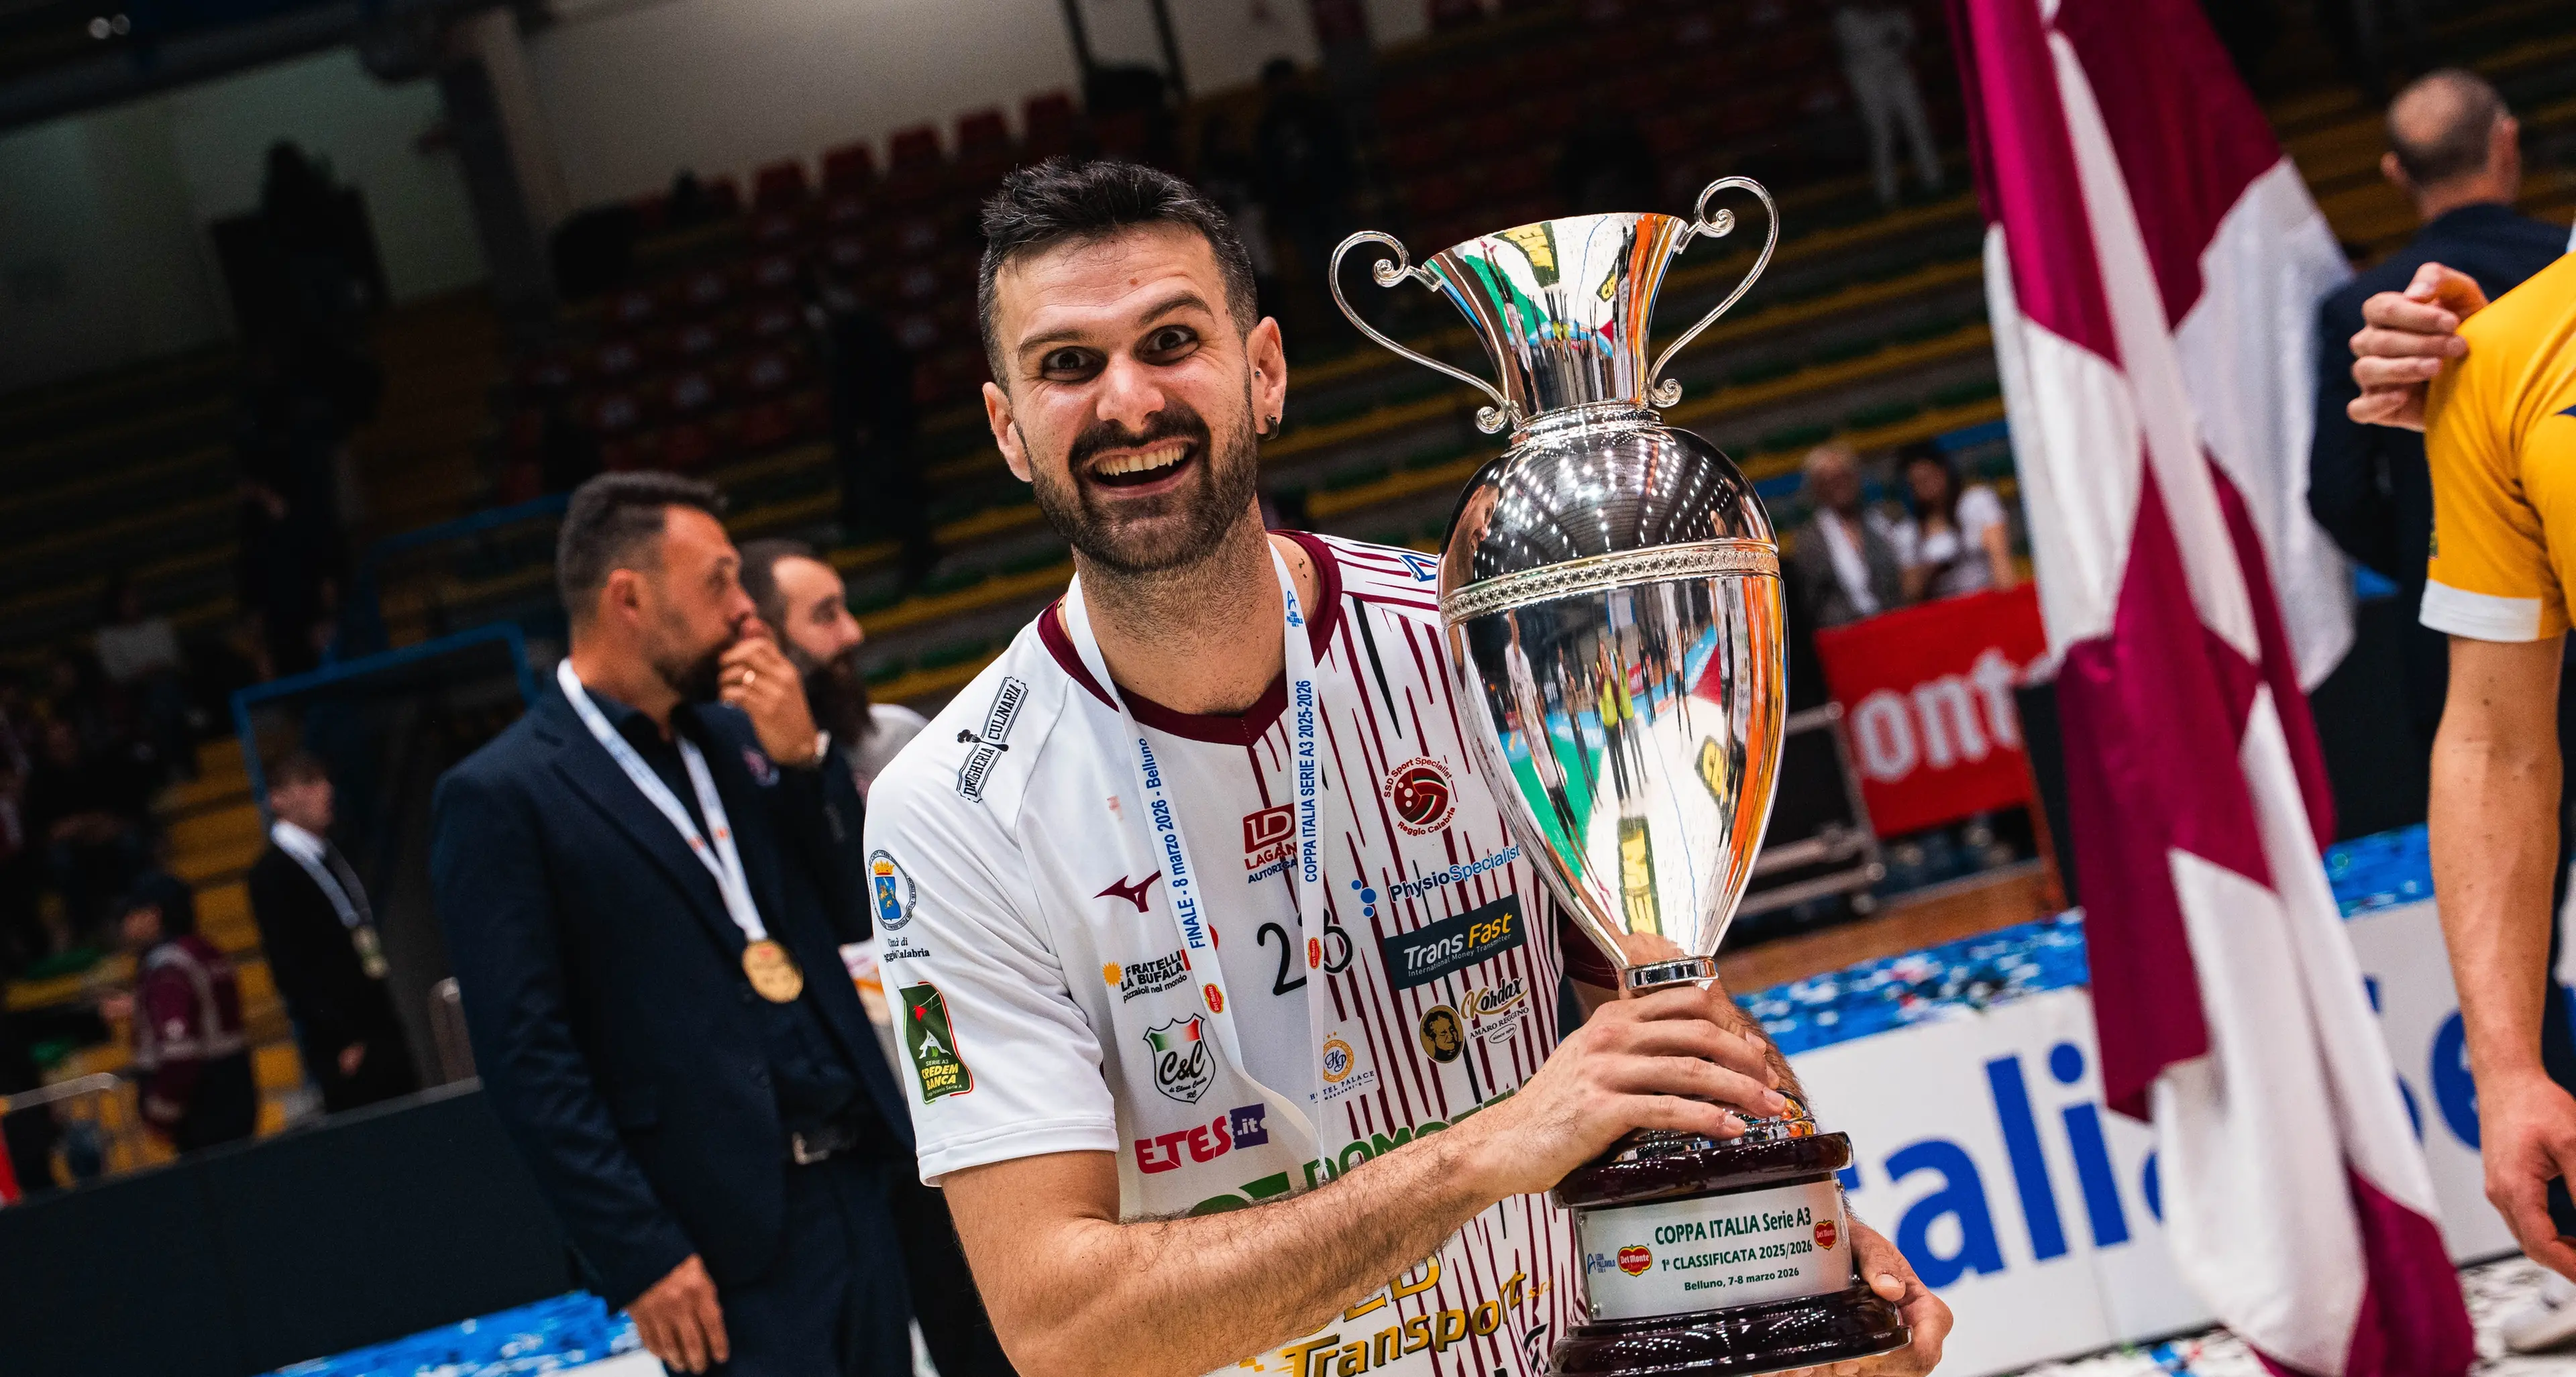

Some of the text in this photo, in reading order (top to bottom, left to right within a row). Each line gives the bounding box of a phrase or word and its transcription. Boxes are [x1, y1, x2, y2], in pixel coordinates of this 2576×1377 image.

[988, 683, 1021, 740] CULINARIA
[1138, 738, 1163, 789] Belluno
[1384, 757, 1452, 798] SSD Sport Specialist
[1295, 680, 1318, 883] COPPA ITALIA SERIE A3 2025-2026
[1150, 799, 1175, 832] 2026
[1397, 807, 1456, 837] Reggio Calabria
[1164, 834, 1186, 876] marzo
[1173, 878, 1189, 887] 8
[1389, 844, 1520, 902] PhysioSpecialist
[1177, 897, 1205, 949] FINALE
[901, 937, 908, 946] di
[1404, 912, 1513, 970] Trans Fast
[1408, 933, 1511, 977] International Money Transmitter
[1120, 962, 1185, 992] LA BUFALA
[1125, 950, 1181, 977] FRATELLI
[1123, 973, 1187, 1003] pizzaioli nel mondo
[1460, 977, 1525, 1020] Kordax
[1470, 1007, 1529, 1040] AMARO REGGINO
[922, 1063, 959, 1080] CREDEM
[1159, 1040, 1205, 1085] C&C
[926, 1075, 957, 1091] BANCA
[1309, 1070, 1375, 1100] HTEL PALACE
[1654, 1207, 1811, 1245] COPPA ITALIA Serie A3
[1619, 1254, 1650, 1264] Del Monte
[1662, 1240, 1813, 1272] 1ª CLASSIFICATA 2025/2026
[1684, 1268, 1800, 1291] Belluno, 7-8 marzo 2026
[1281, 1270, 1527, 1377] Transport
